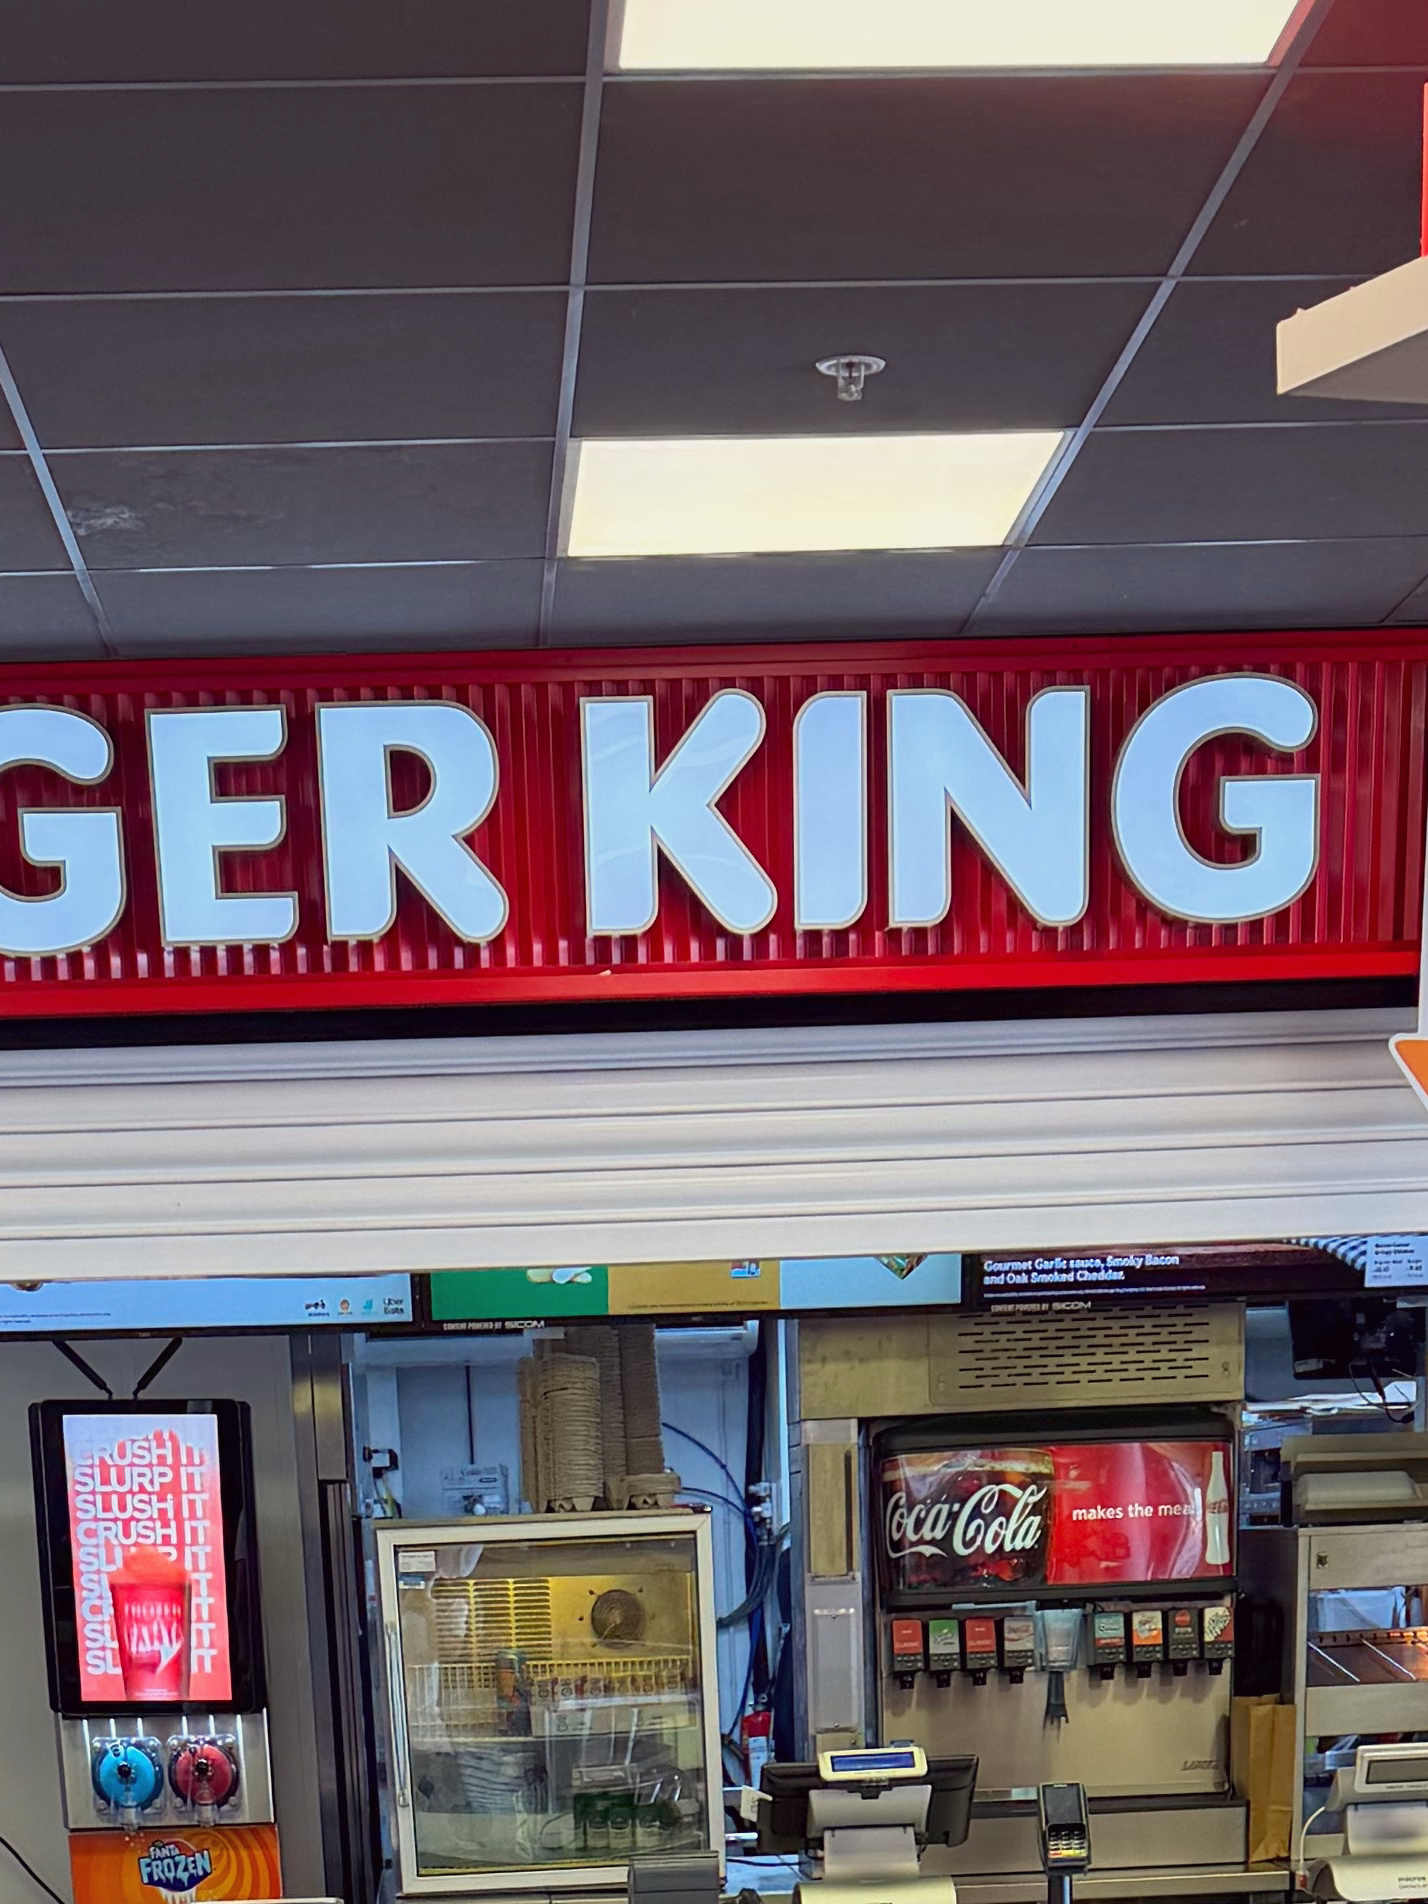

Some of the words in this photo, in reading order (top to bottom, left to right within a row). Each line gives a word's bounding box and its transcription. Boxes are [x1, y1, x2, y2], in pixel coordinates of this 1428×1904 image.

[579, 671, 1321, 938] KING
[983, 1260, 1032, 1271] Gourmet
[1035, 1258, 1067, 1270] Garlic
[1106, 1255, 1143, 1268] Smoky
[1145, 1254, 1180, 1266] Bacon
[983, 1273, 1005, 1285] and
[1006, 1272, 1029, 1284] Oak
[1031, 1271, 1074, 1283] Smoked
[73, 1440, 172, 1466] CRUSH
[180, 1442, 206, 1465] IT
[74, 1466, 173, 1492] SLURP
[180, 1466, 207, 1492] IT
[75, 1493, 174, 1519] SLUSH
[181, 1493, 209, 1519] IT
[1072, 1504, 1123, 1520] makes
[1128, 1503, 1154, 1518] the
[1158, 1503, 1198, 1517] mea
[76, 1520, 177, 1545] CRUSH
[184, 1520, 210, 1545] IT
[886, 1484, 1048, 1559] Coca-Cola
[184, 1546, 212, 1571] IT
[190, 1648, 218, 1674] IT
[139, 1850, 211, 1887] FROZEN
